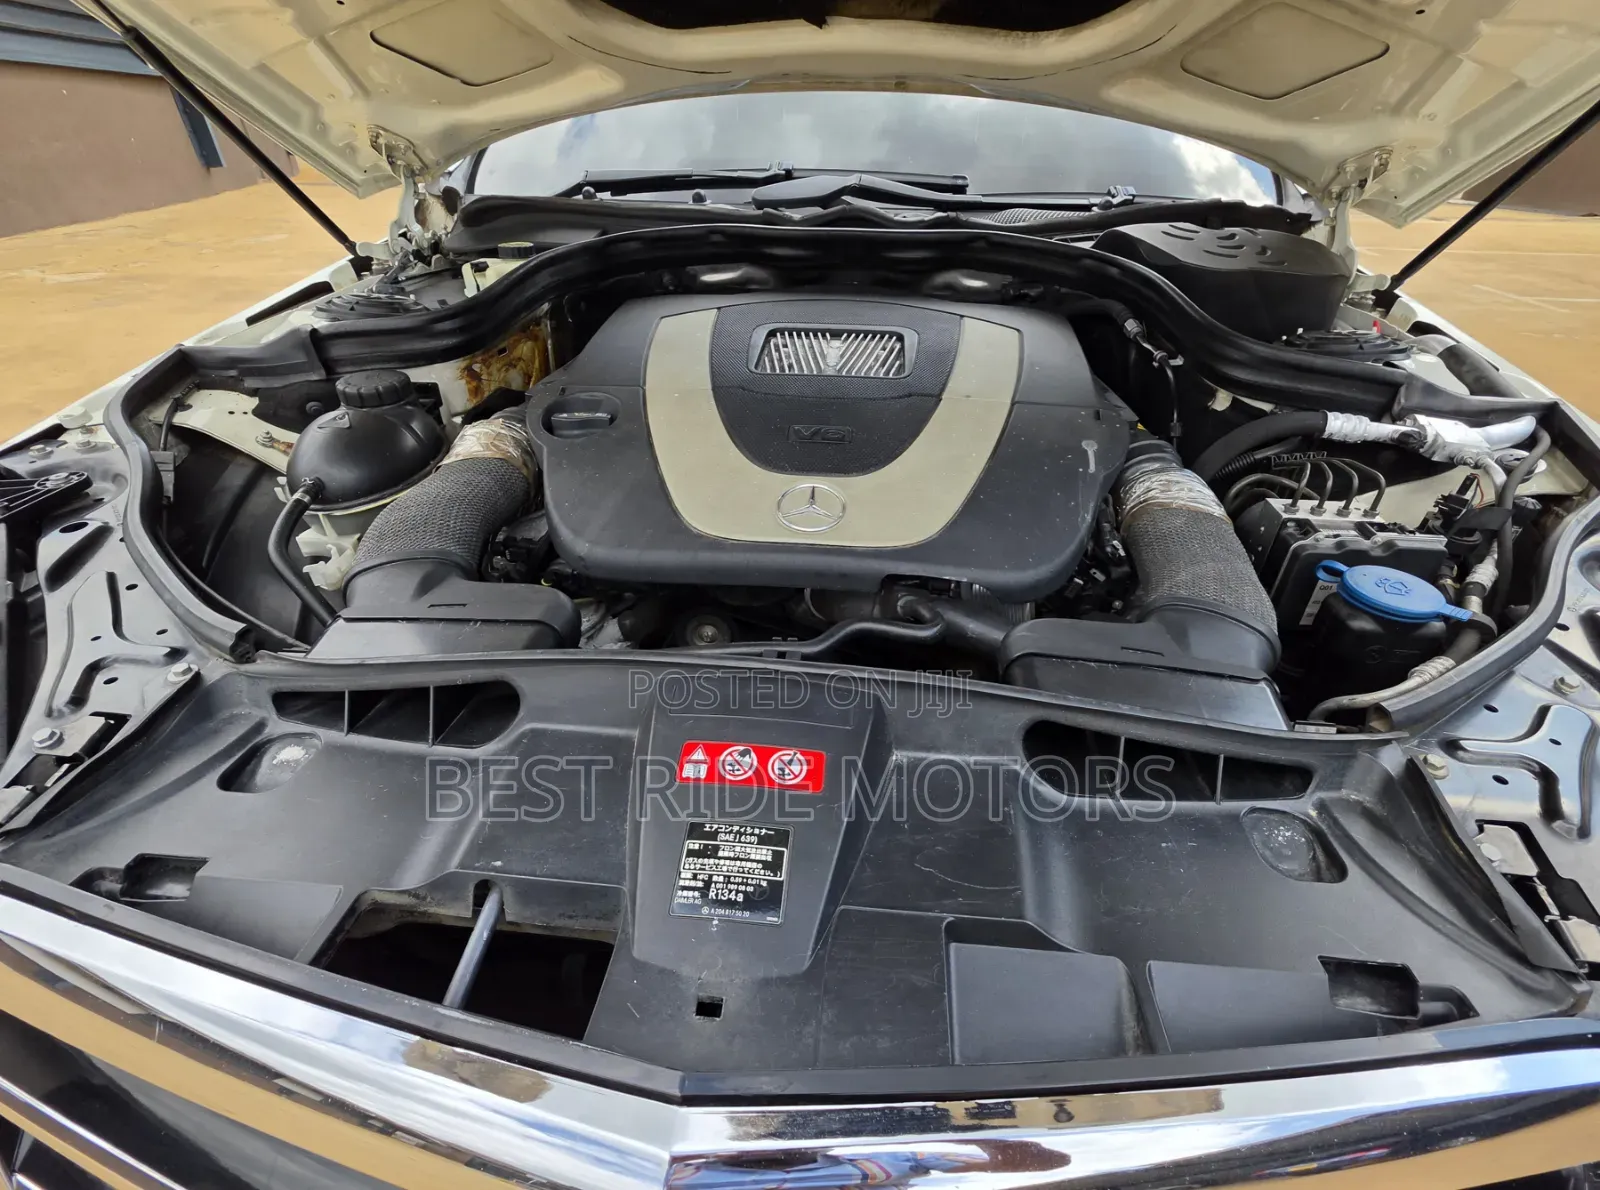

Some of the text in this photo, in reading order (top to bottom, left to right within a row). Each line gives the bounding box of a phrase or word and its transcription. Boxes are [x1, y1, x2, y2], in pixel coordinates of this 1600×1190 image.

[793, 425, 846, 441] V6
[703, 823, 775, 835] エアコンディショナー
[717, 833, 735, 842] (SAE
[741, 835, 758, 844] 639)
[708, 888, 744, 902] R134a
